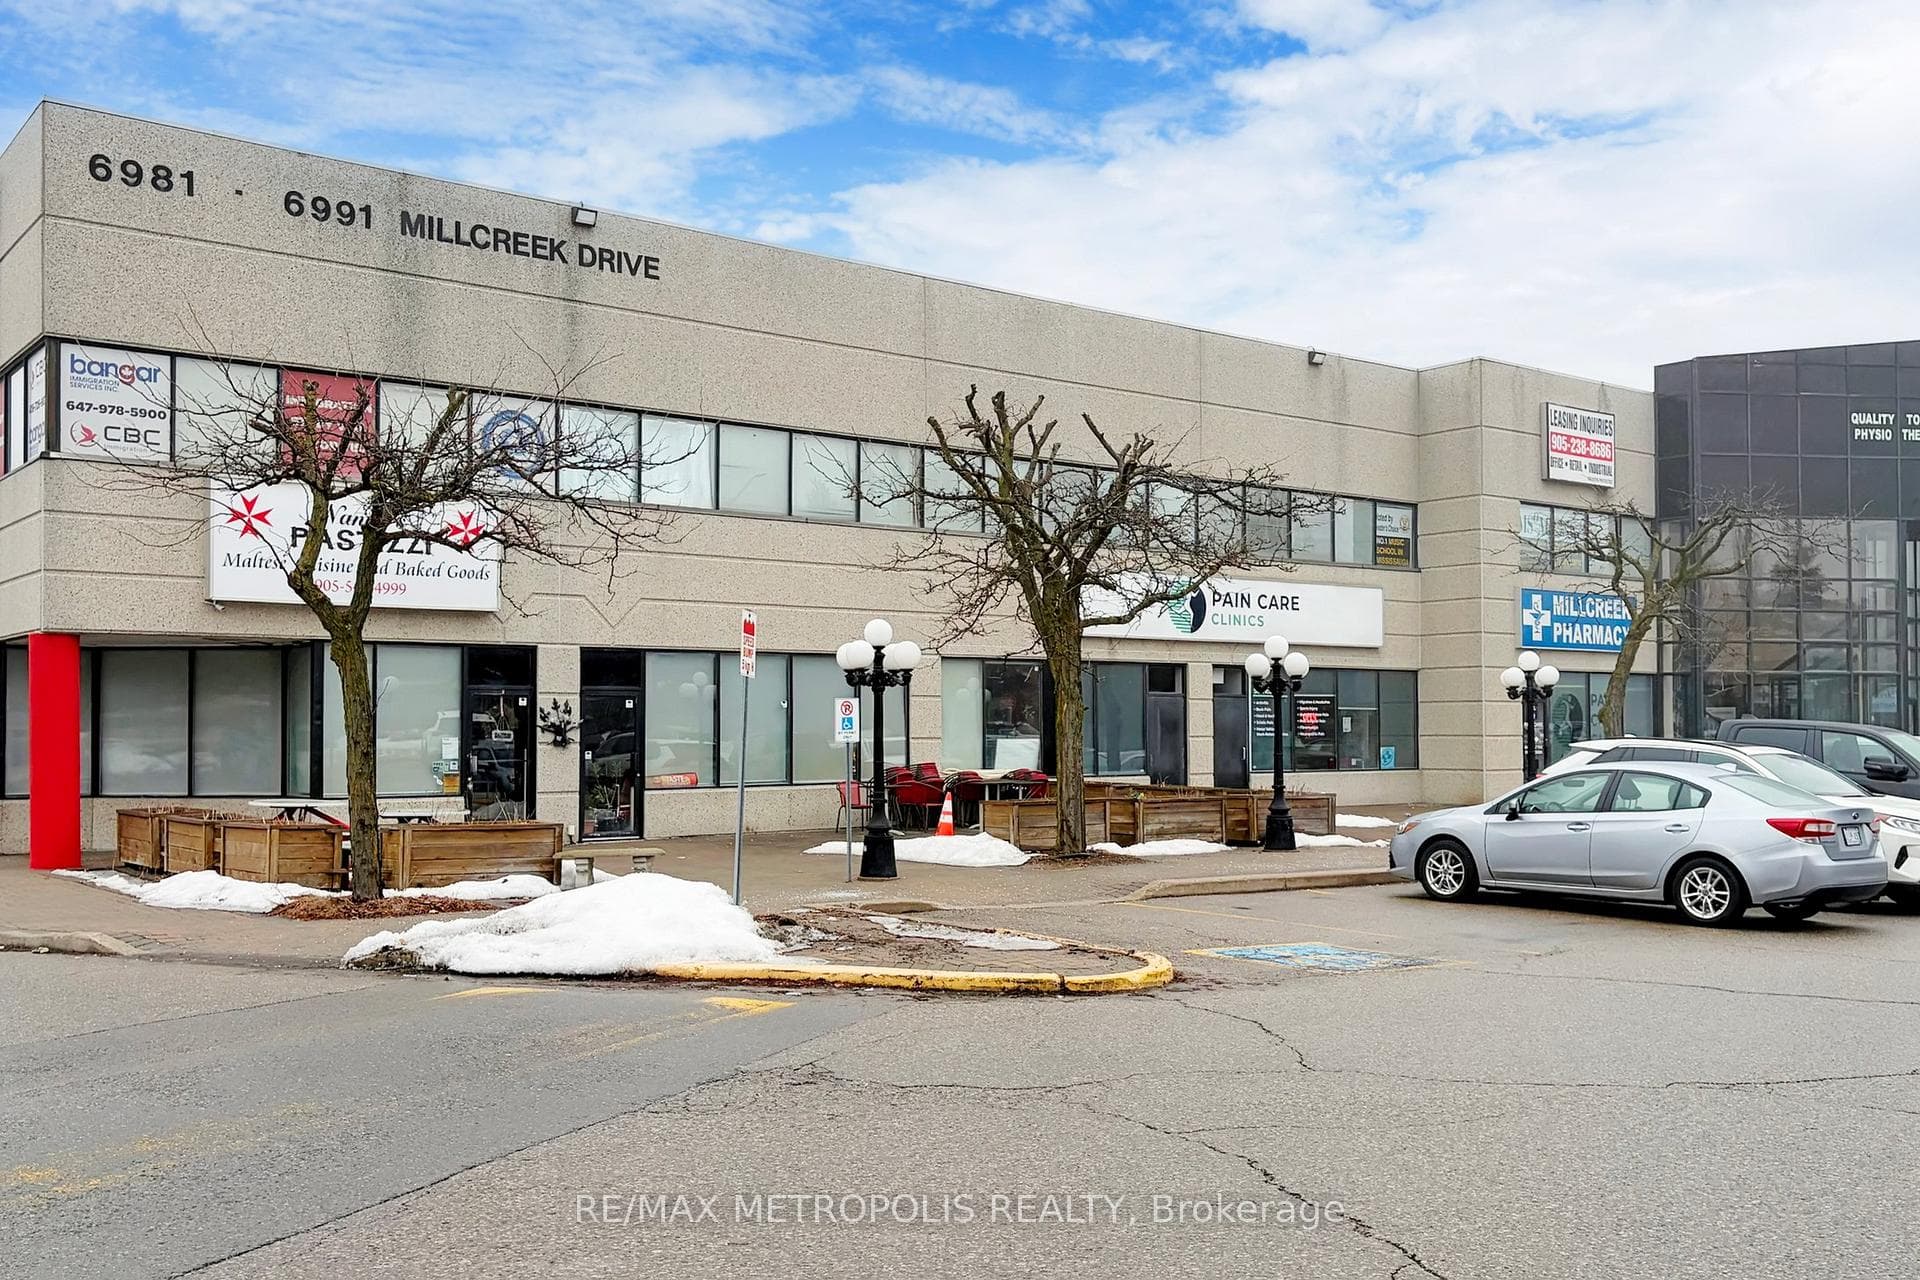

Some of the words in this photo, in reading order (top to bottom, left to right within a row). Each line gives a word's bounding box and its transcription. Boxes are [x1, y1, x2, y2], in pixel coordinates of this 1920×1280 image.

[89, 154, 194, 197] 6981
[284, 190, 372, 229] 6991
[400, 210, 568, 264] MILLCREEK
[578, 243, 660, 280] DRIVE
[70, 353, 160, 385] bangar
[70, 375, 120, 387] IMMIGRATION
[70, 381, 103, 391] SERVICES
[66, 400, 167, 420] 647-978-5900
[1851, 412, 1895, 425] QUALITY
[1550, 408, 1578, 431] LEASING
[1580, 414, 1613, 437] INQUIRIES
[104, 426, 160, 446] CBC
[1854, 428, 1892, 440] PHYSIO
[1902, 428, 1920, 441] THE
[1551, 434, 1612, 459] 905-238-8686
[396, 558, 442, 577] Baked
[447, 565, 490, 581] Goods
[1212, 589, 1251, 609] PAIN
[1257, 594, 1300, 611] CARE
[1552, 594, 1632, 621] MILLCREEK
[1211, 613, 1264, 627] CLINICS
